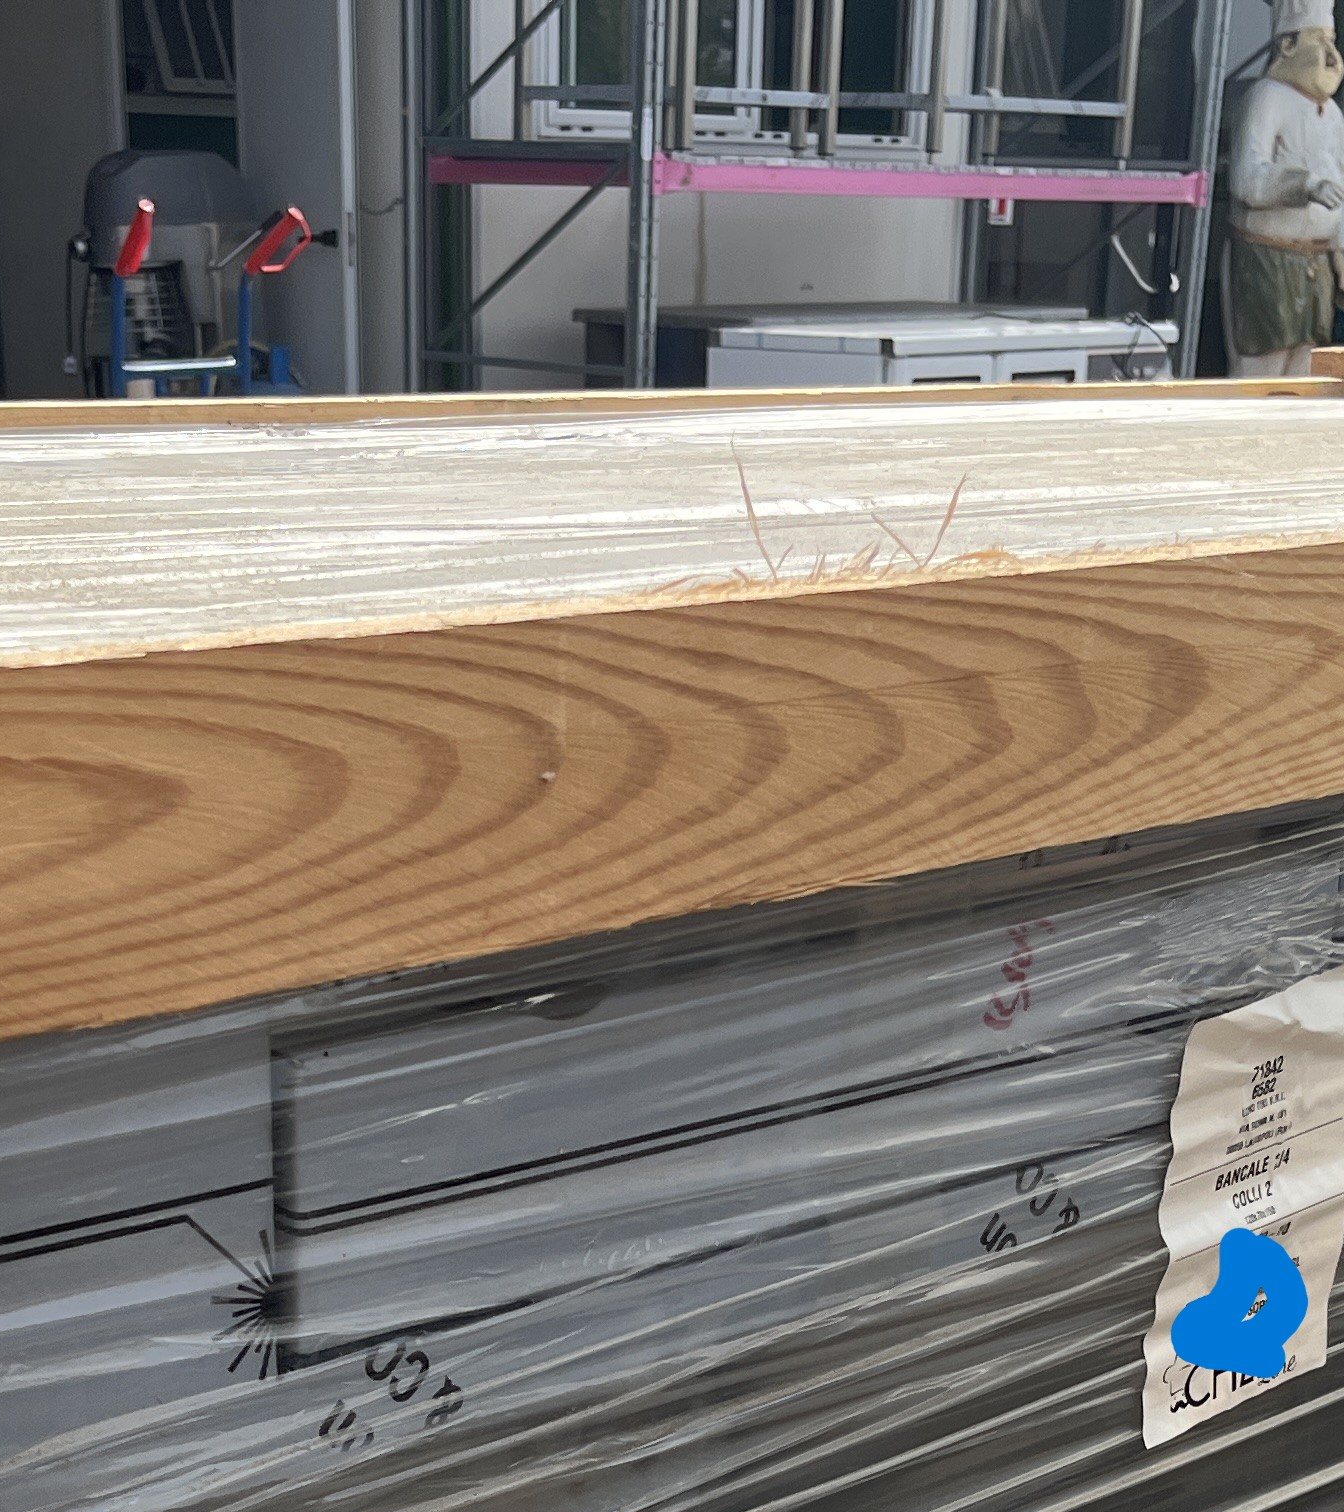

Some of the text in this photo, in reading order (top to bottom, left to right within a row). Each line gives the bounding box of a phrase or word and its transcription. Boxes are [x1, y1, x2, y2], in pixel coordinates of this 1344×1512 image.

[1251, 1055, 1284, 1083] 71842
[1215, 1156, 1270, 1191] BANCALE
[1232, 1180, 1274, 1209] COLLI 2
